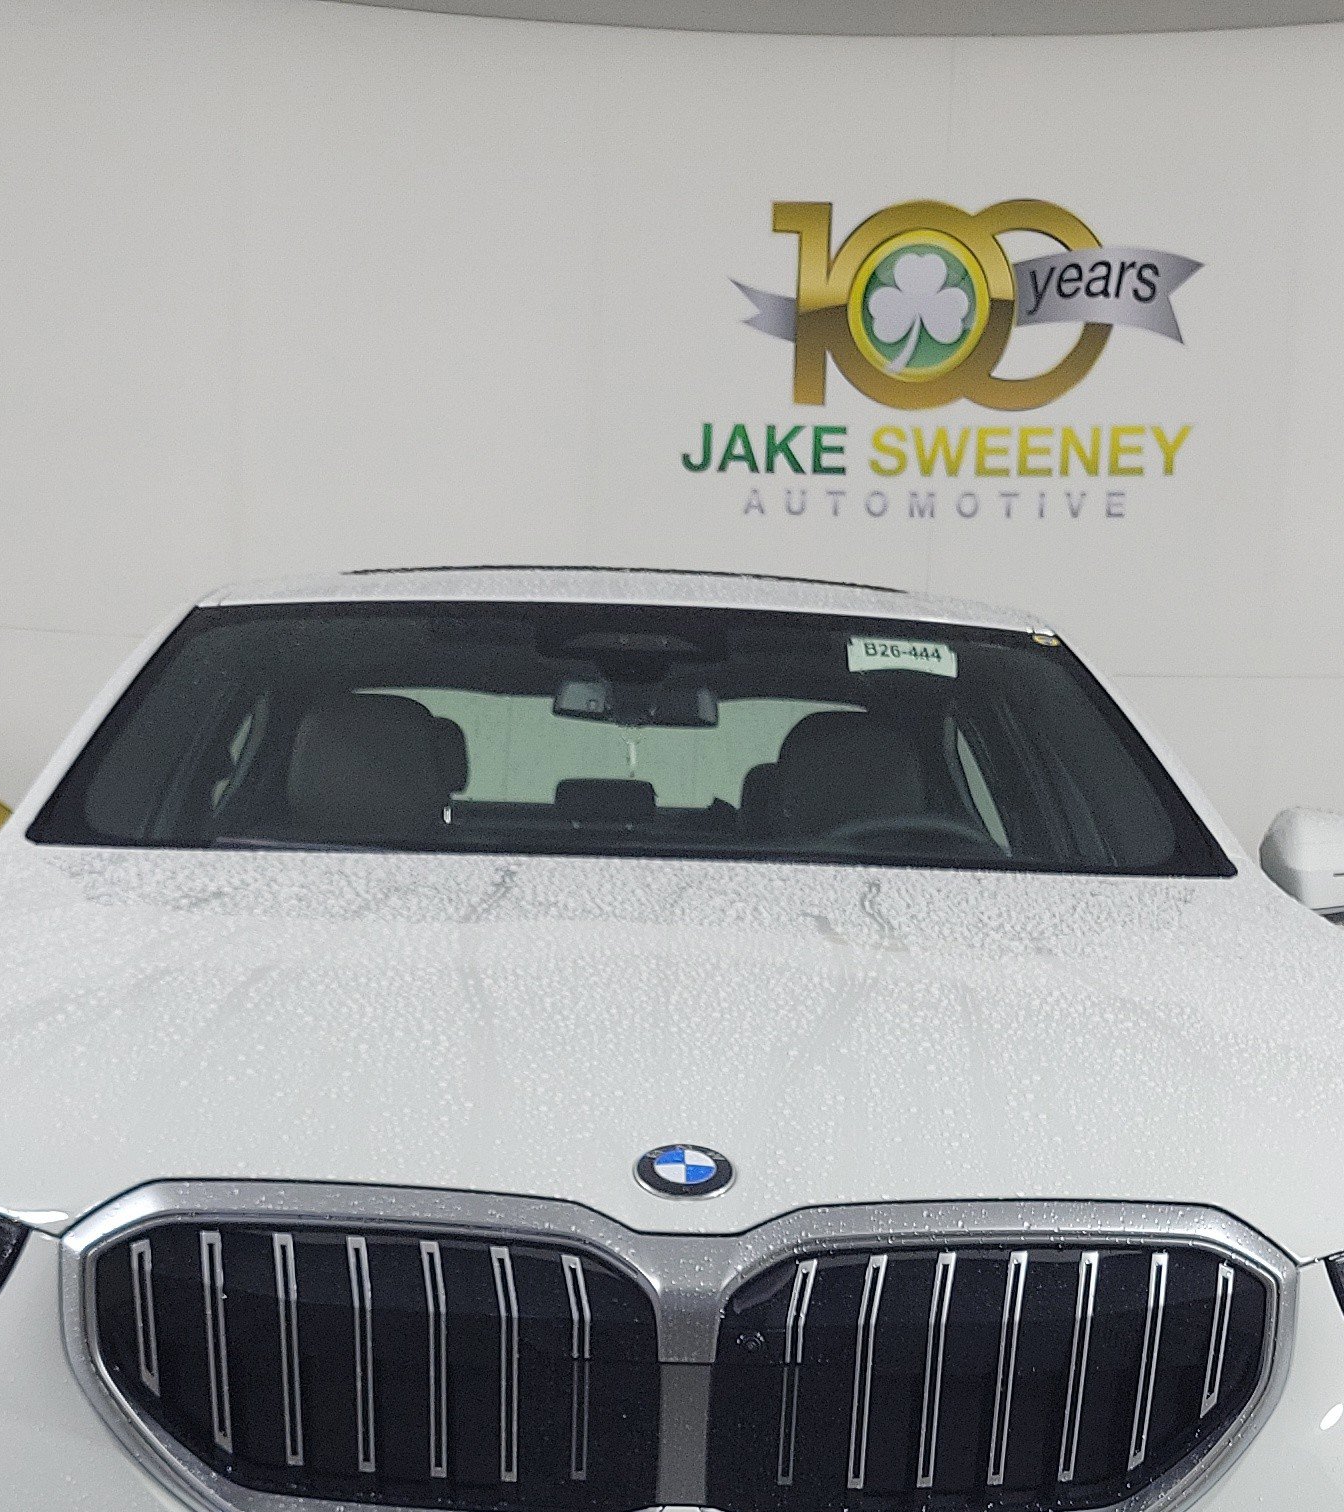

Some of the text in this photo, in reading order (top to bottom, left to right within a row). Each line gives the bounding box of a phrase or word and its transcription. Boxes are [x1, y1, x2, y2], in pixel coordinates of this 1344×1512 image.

[772, 199, 1114, 411] 100
[1029, 256, 1160, 315] years
[681, 423, 1193, 477] JAKE SWEENEY
[743, 490, 1128, 519] AUTOMOTIVE
[864, 642, 942, 662] B26-444
